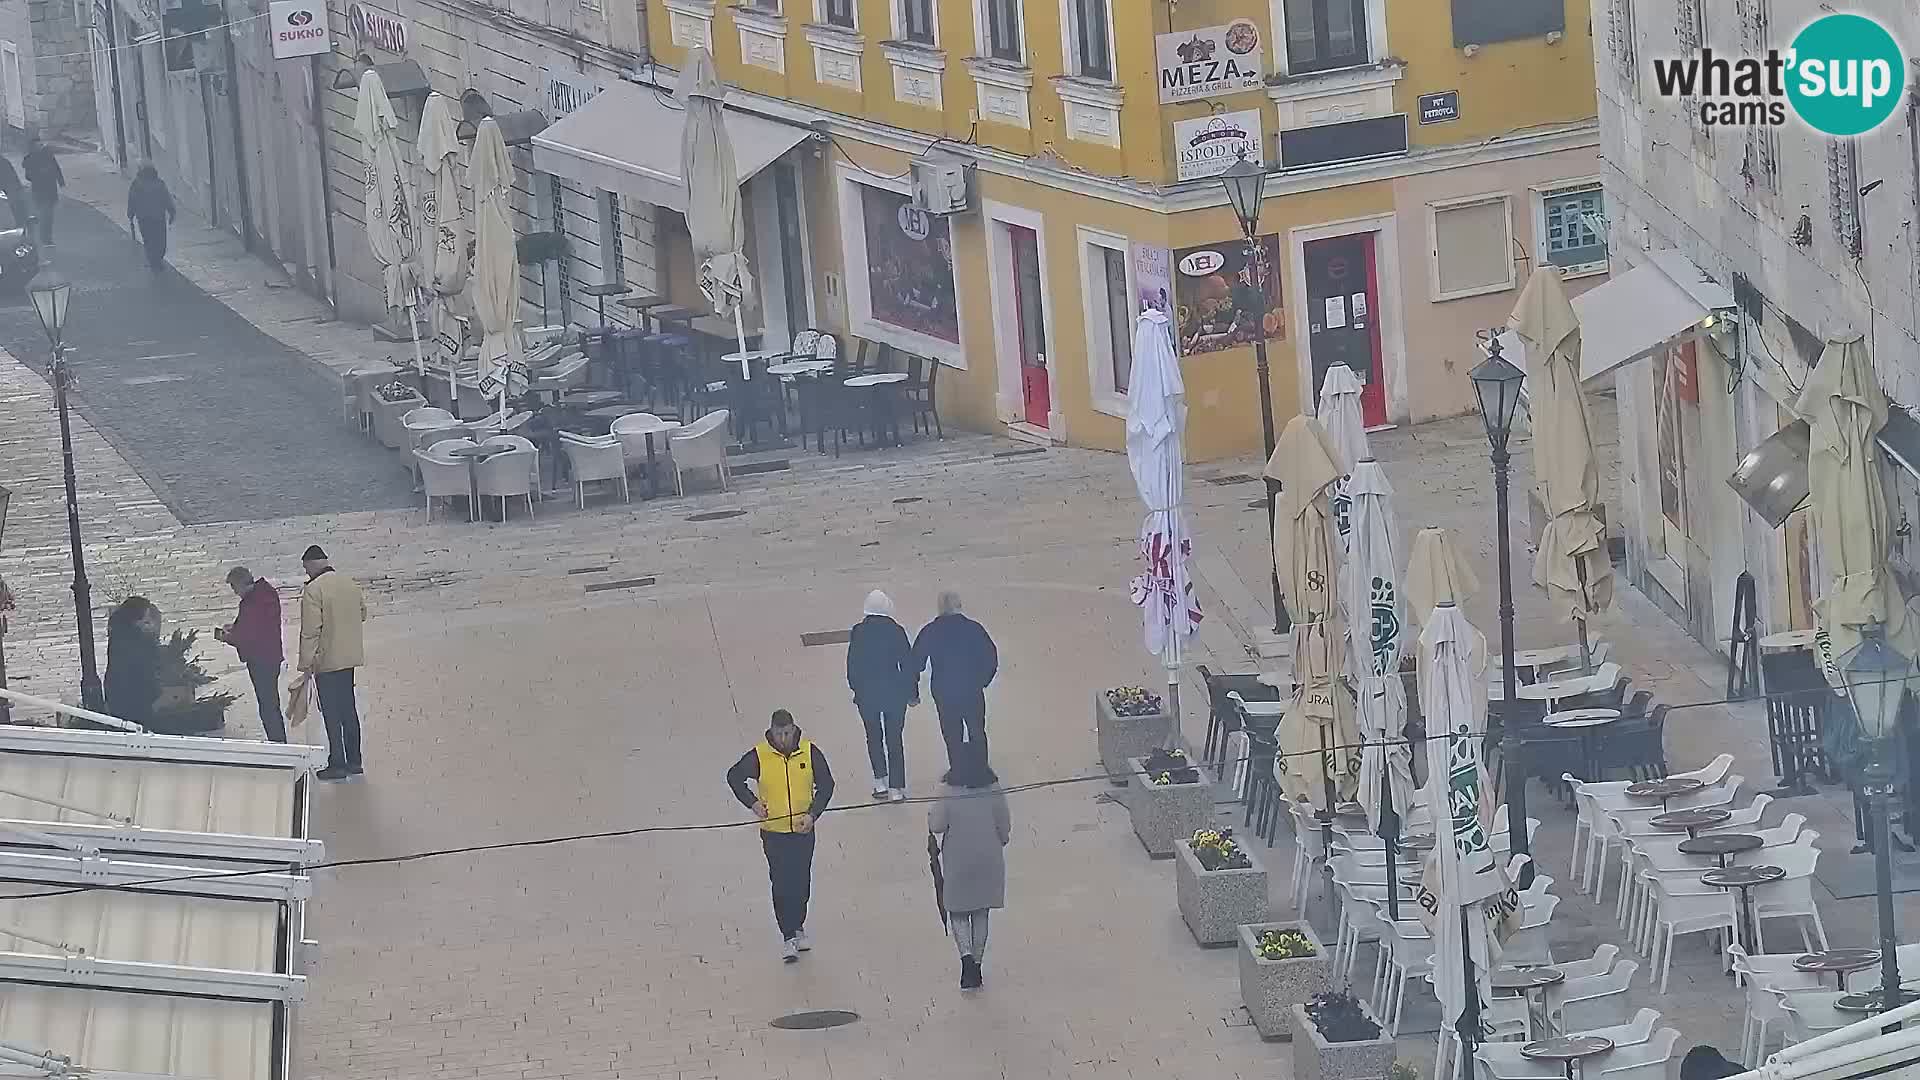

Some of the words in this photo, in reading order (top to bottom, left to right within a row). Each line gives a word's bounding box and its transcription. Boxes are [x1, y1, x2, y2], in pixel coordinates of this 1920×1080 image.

[280, 28, 323, 41] SUKNO
[366, 12, 405, 52] SUKNO
[1162, 59, 1240, 88] MEZA
[1171, 84, 1203, 96] PIZZERIA
[1204, 83, 1211, 92] &
[1212, 80, 1232, 91] GRILL
[1432, 98, 1444, 106] PUT
[1424, 106, 1455, 118] PETROVCA
[1181, 144, 1226, 162] ISPOD
[1231, 139, 1260, 155] URE
